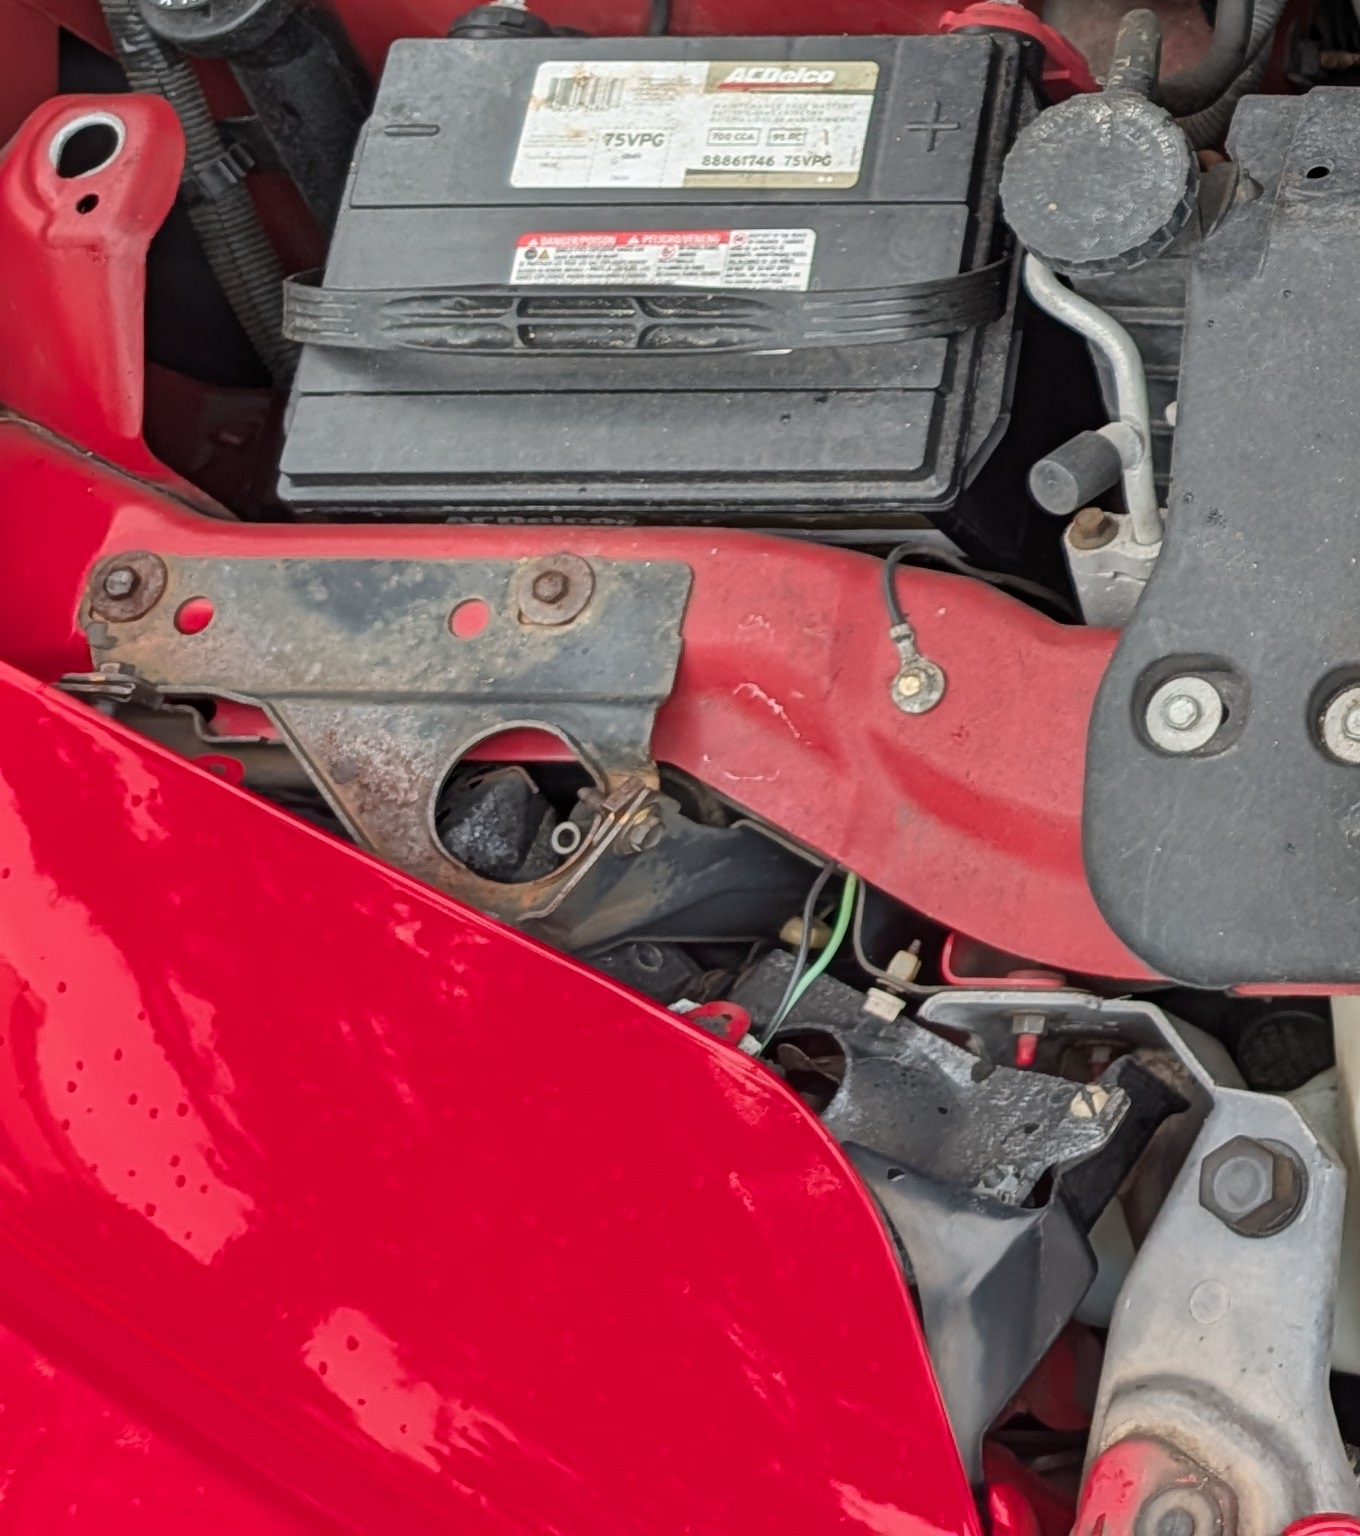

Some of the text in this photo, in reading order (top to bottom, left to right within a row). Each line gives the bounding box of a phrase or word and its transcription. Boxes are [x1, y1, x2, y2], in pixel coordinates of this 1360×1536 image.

[725, 68, 836, 84] ACDelco
[604, 132, 665, 148] 75VPG
[784, 154, 832, 167] 75VPG
